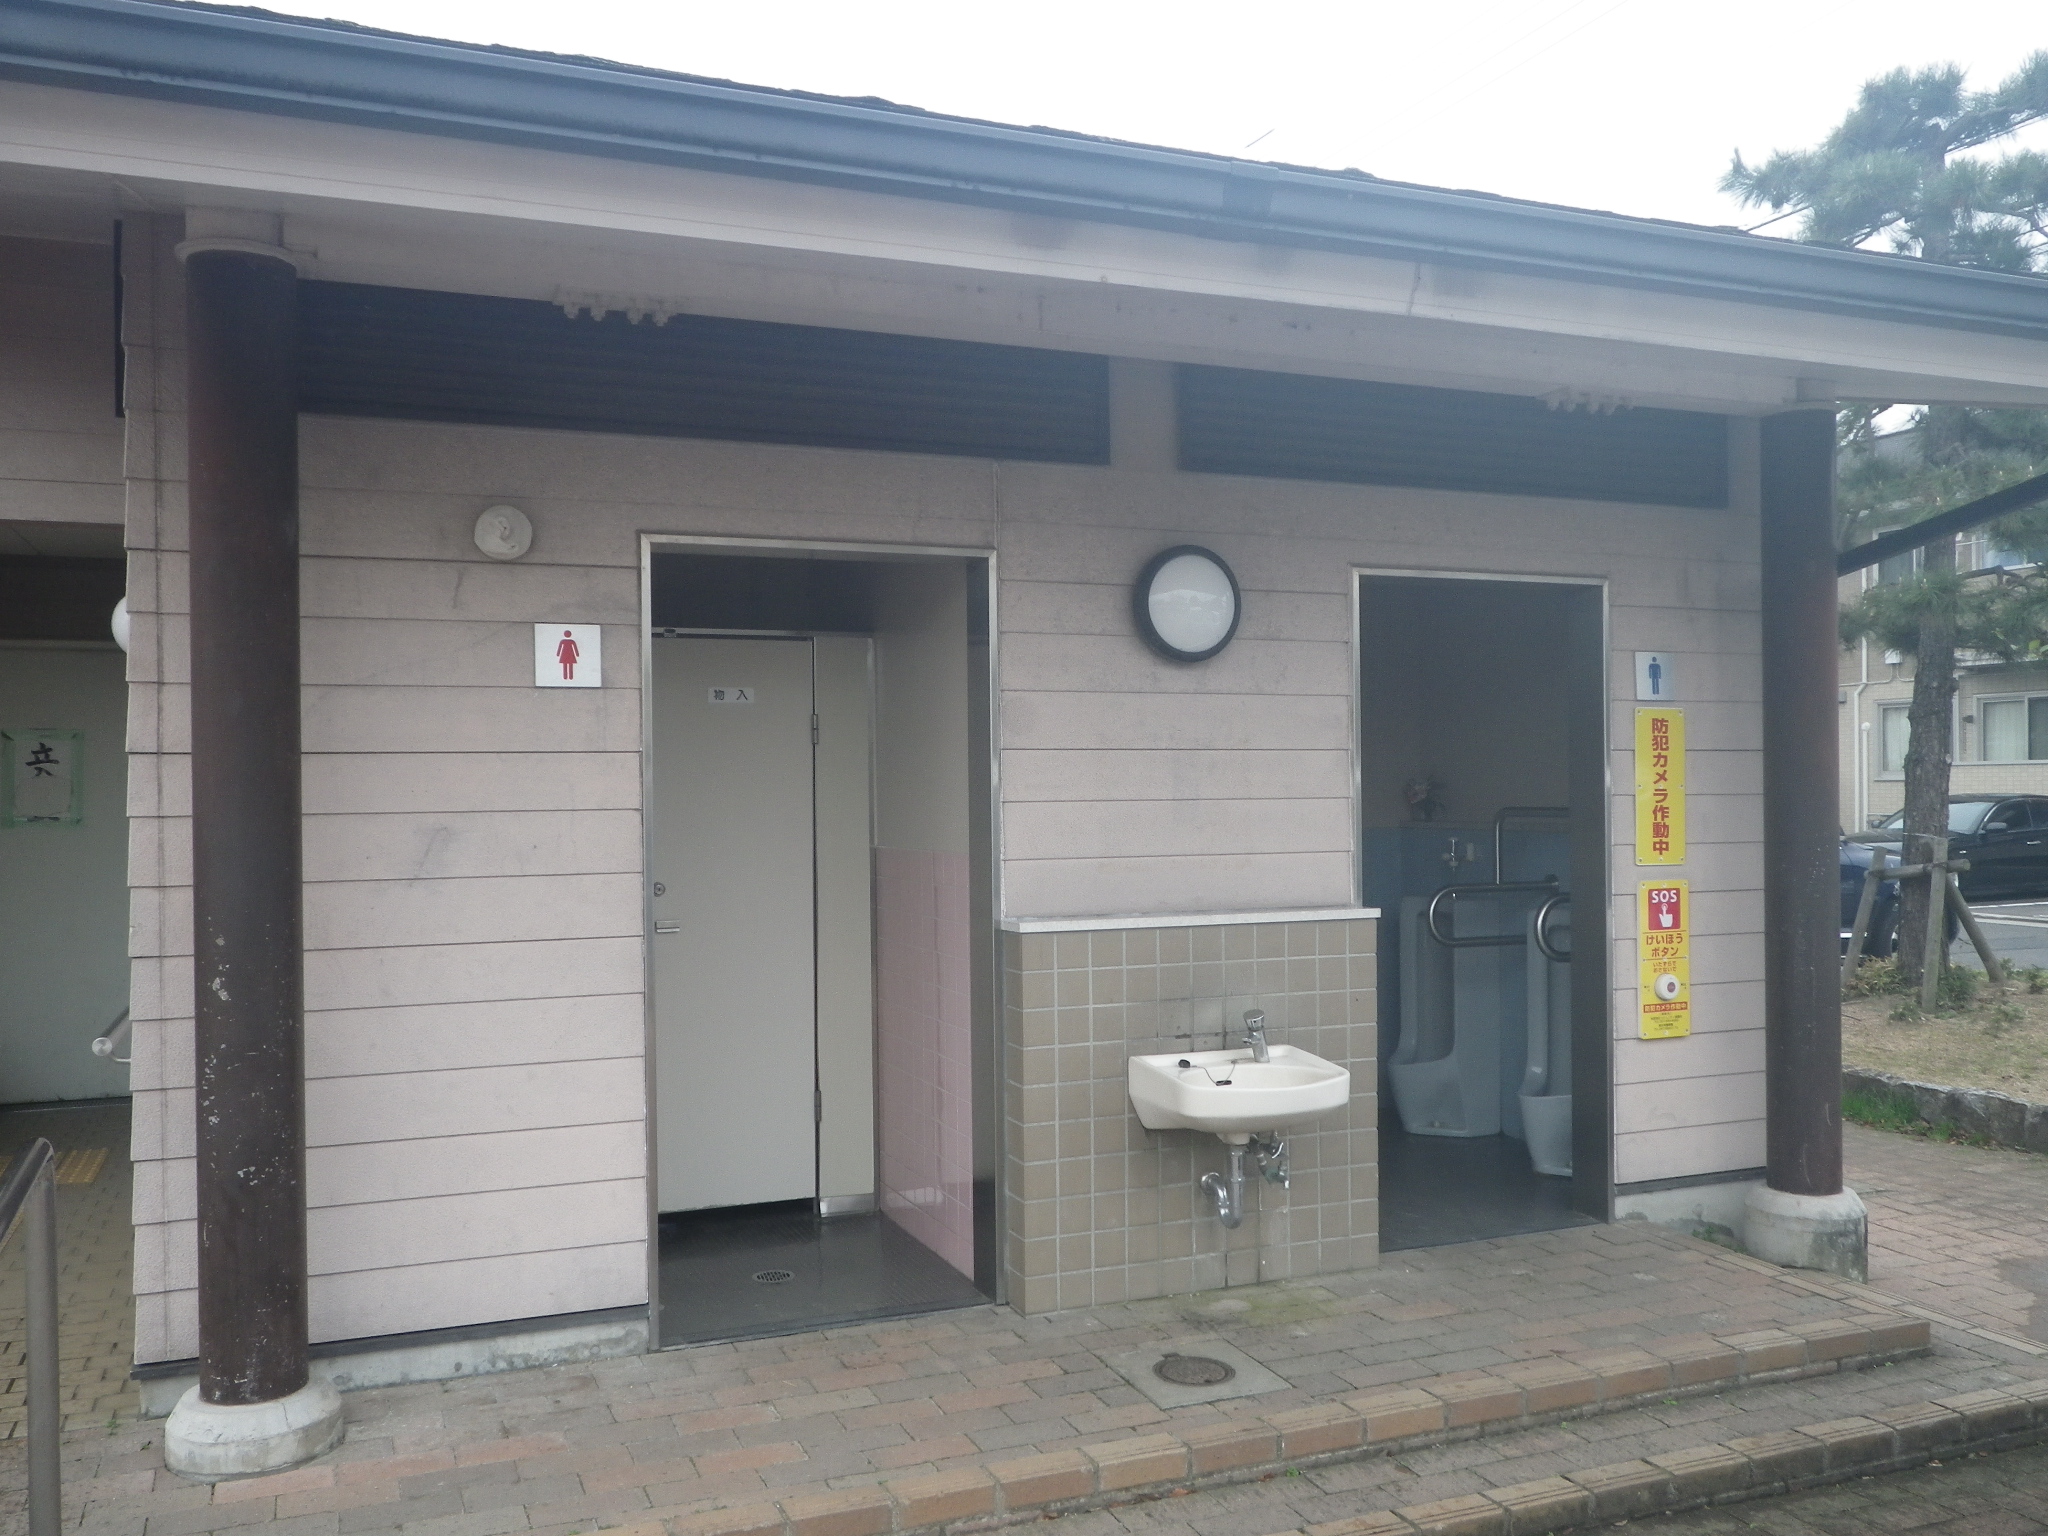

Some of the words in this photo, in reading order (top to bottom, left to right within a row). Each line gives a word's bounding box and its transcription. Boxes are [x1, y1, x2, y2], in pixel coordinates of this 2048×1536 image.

[1651, 717, 1670, 856] 防犯カメラ作動中
[1651, 889, 1678, 904] SOS
[1646, 932, 1683, 946] けいほう
[1651, 946, 1679, 958] ボタン
